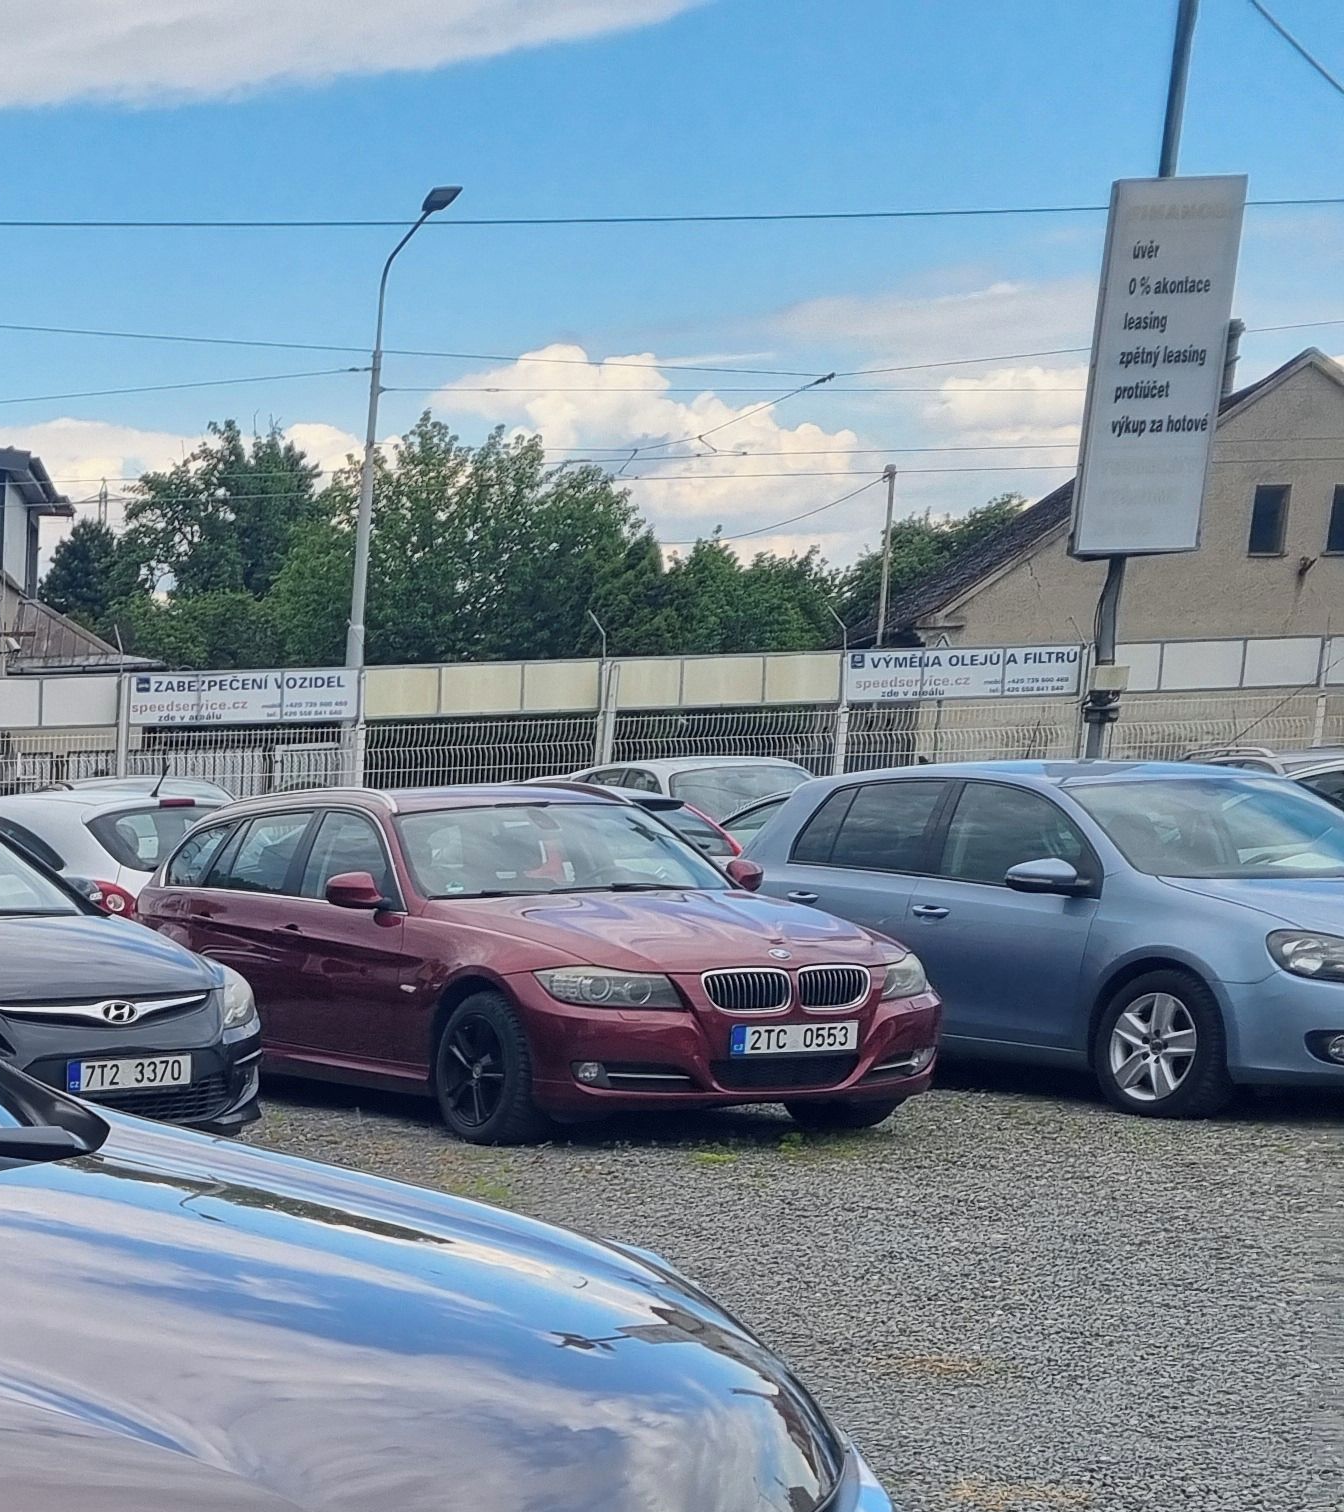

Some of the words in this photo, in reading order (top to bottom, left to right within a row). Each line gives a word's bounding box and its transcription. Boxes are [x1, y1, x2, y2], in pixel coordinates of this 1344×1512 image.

[1133, 240, 1160, 260] úvěr
[1128, 278, 1136, 295] 0
[1154, 276, 1211, 295] akontace
[1123, 311, 1167, 333] leasing
[1119, 346, 1161, 368] zpětný
[1162, 344, 1207, 366] leasing
[1113, 380, 1170, 403] protiúčet
[1112, 415, 1146, 437] výkup
[1149, 418, 1163, 433] za
[1166, 413, 1208, 433] hotové
[871, 653, 942, 669] VÝMĚNA
[949, 653, 1001, 667] OLEJŮ
[1006, 652, 1018, 665] A
[1024, 650, 1078, 665] FILTRŮ
[154, 675, 269, 693] ZABEZPEČENÍ
[274, 676, 345, 691] VOZIDEL
[881, 689, 899, 698] zde
[158, 713, 176, 722] zde
[750, 1029, 788, 1051] 2TC
[803, 1026, 849, 1048] 0553
[85, 1064, 120, 1088] 7T2
[134, 1059, 182, 1083] 3370
